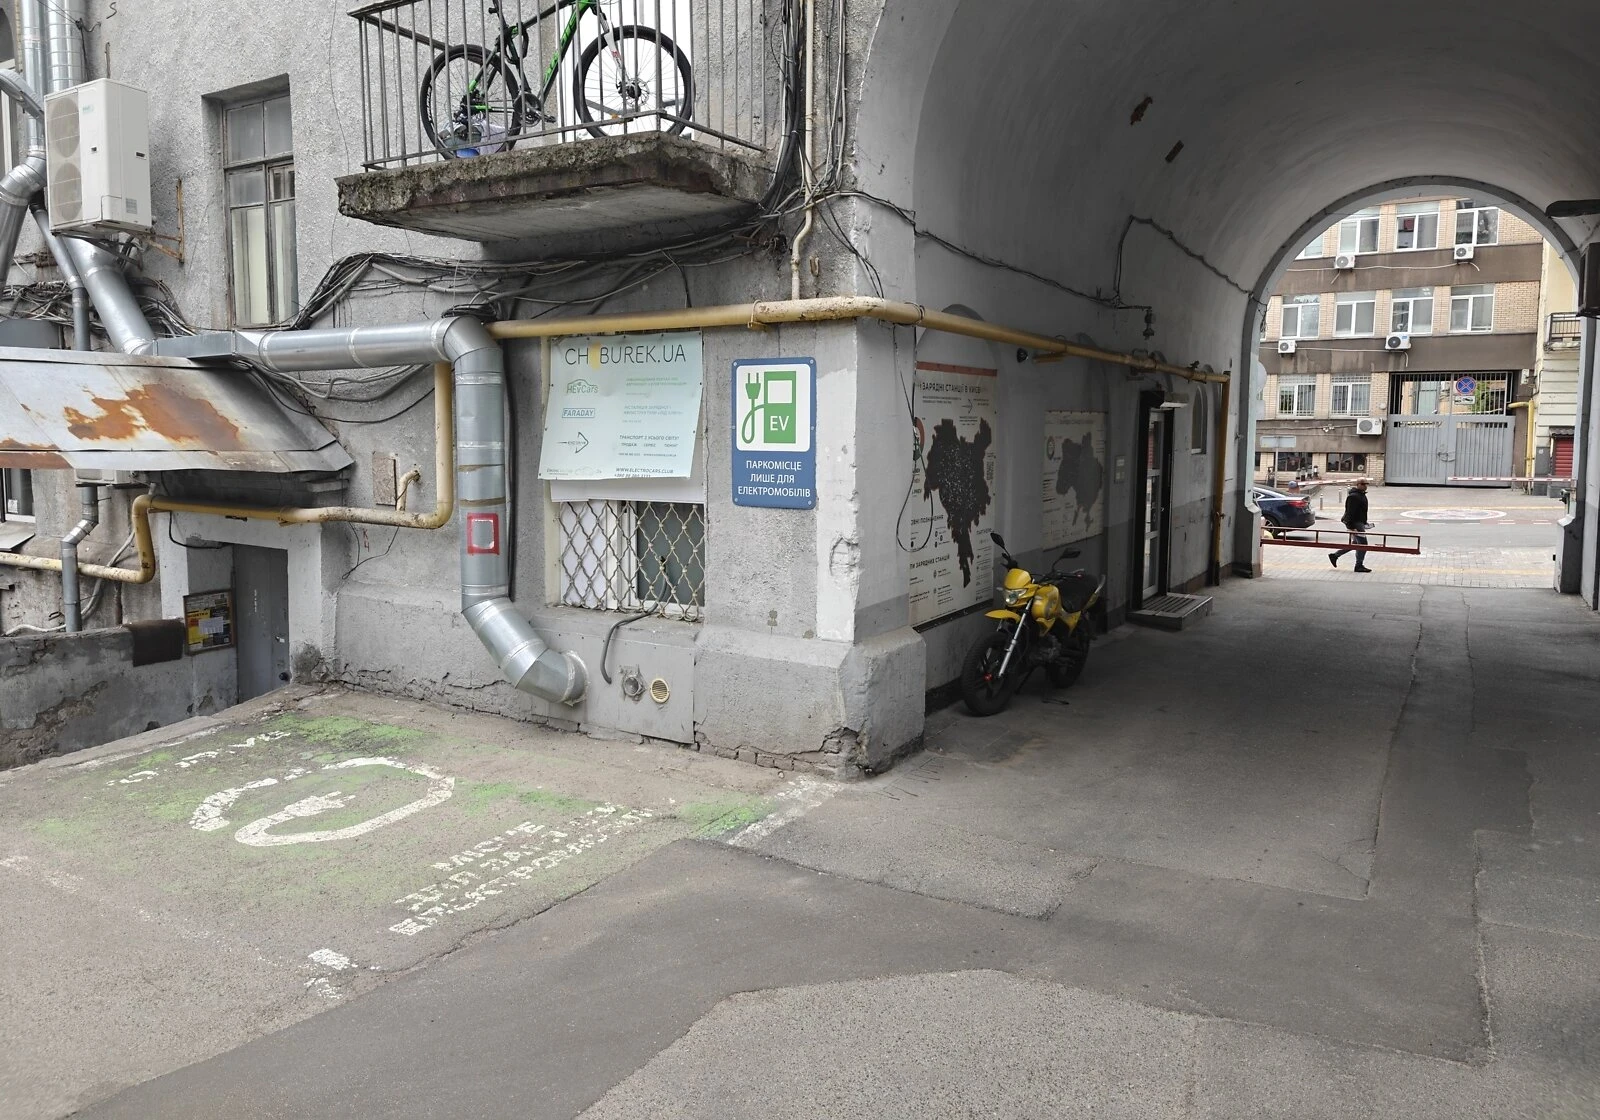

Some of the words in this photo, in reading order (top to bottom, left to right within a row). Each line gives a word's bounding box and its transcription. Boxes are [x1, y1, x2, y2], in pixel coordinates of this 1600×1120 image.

[563, 409, 594, 417] FARADAY
[769, 415, 789, 431] EV
[746, 460, 802, 471] ПАРКОМІСЦЕ
[750, 473, 775, 483] ЛИШЕ
[776, 474, 795, 484] ДЛЯ
[738, 486, 811, 497] ЕЛЕКТРОМОБІЛІВ
